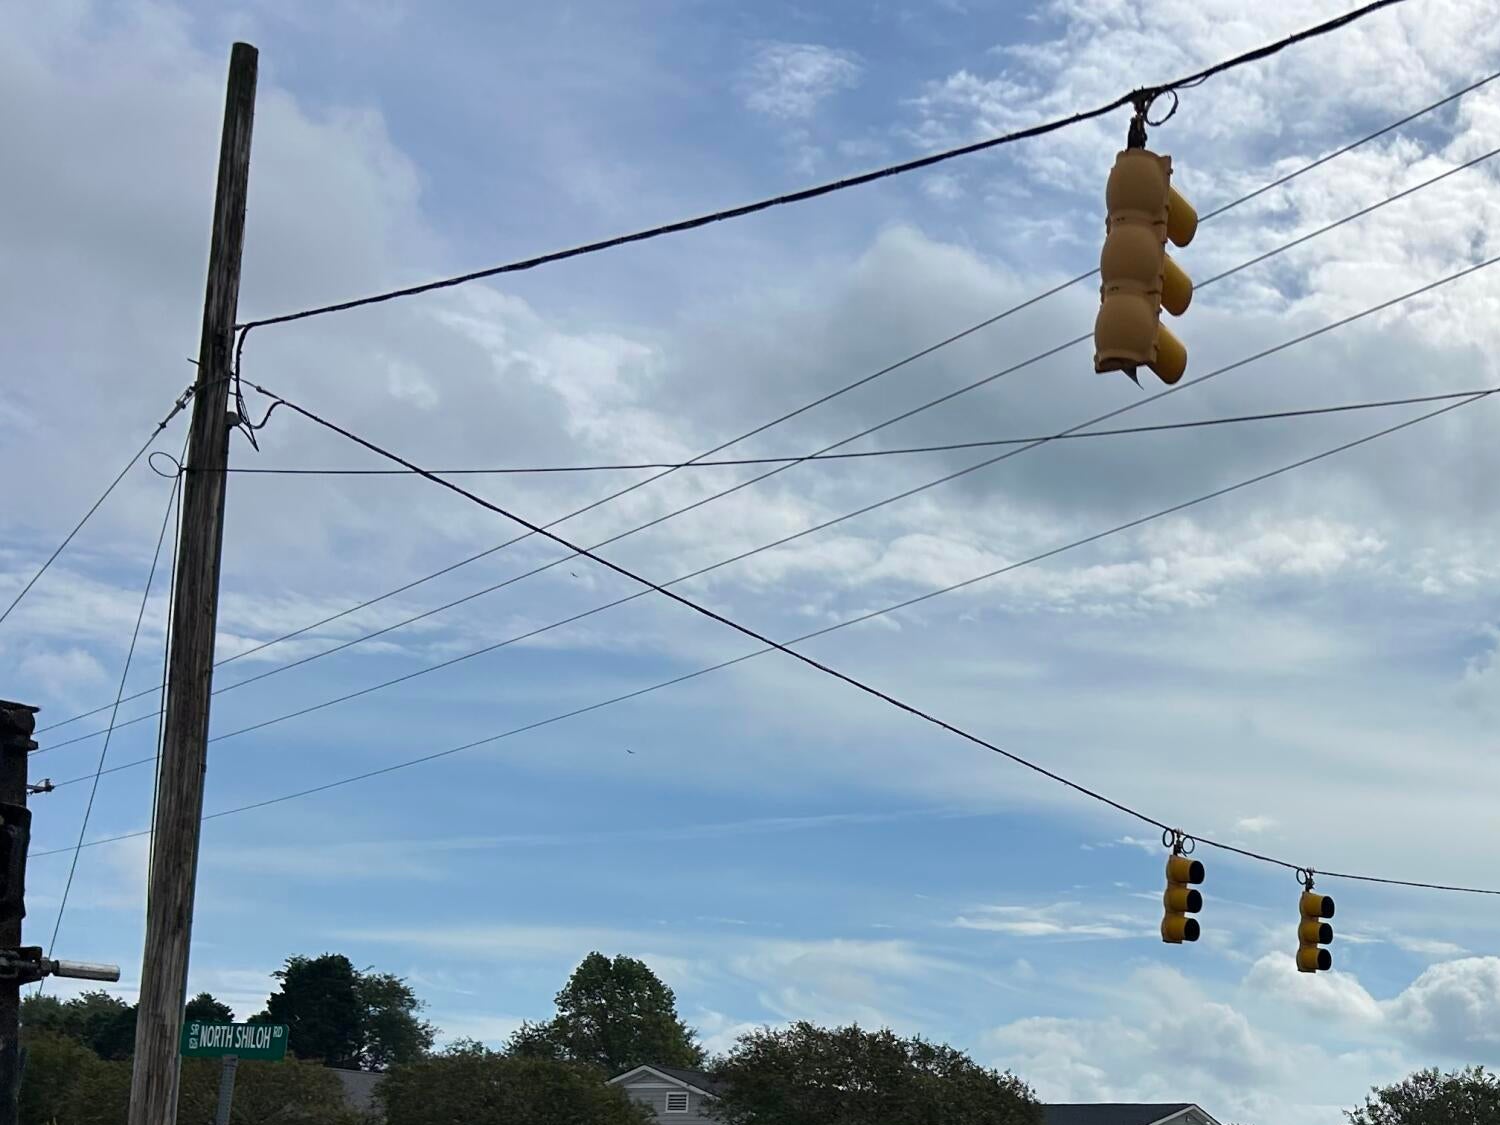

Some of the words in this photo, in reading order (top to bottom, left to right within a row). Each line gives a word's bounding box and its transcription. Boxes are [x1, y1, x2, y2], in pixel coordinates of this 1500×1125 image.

[200, 1025, 234, 1048] NORTH
[235, 1026, 271, 1049] SHILOH
[273, 1026, 283, 1038] RD
